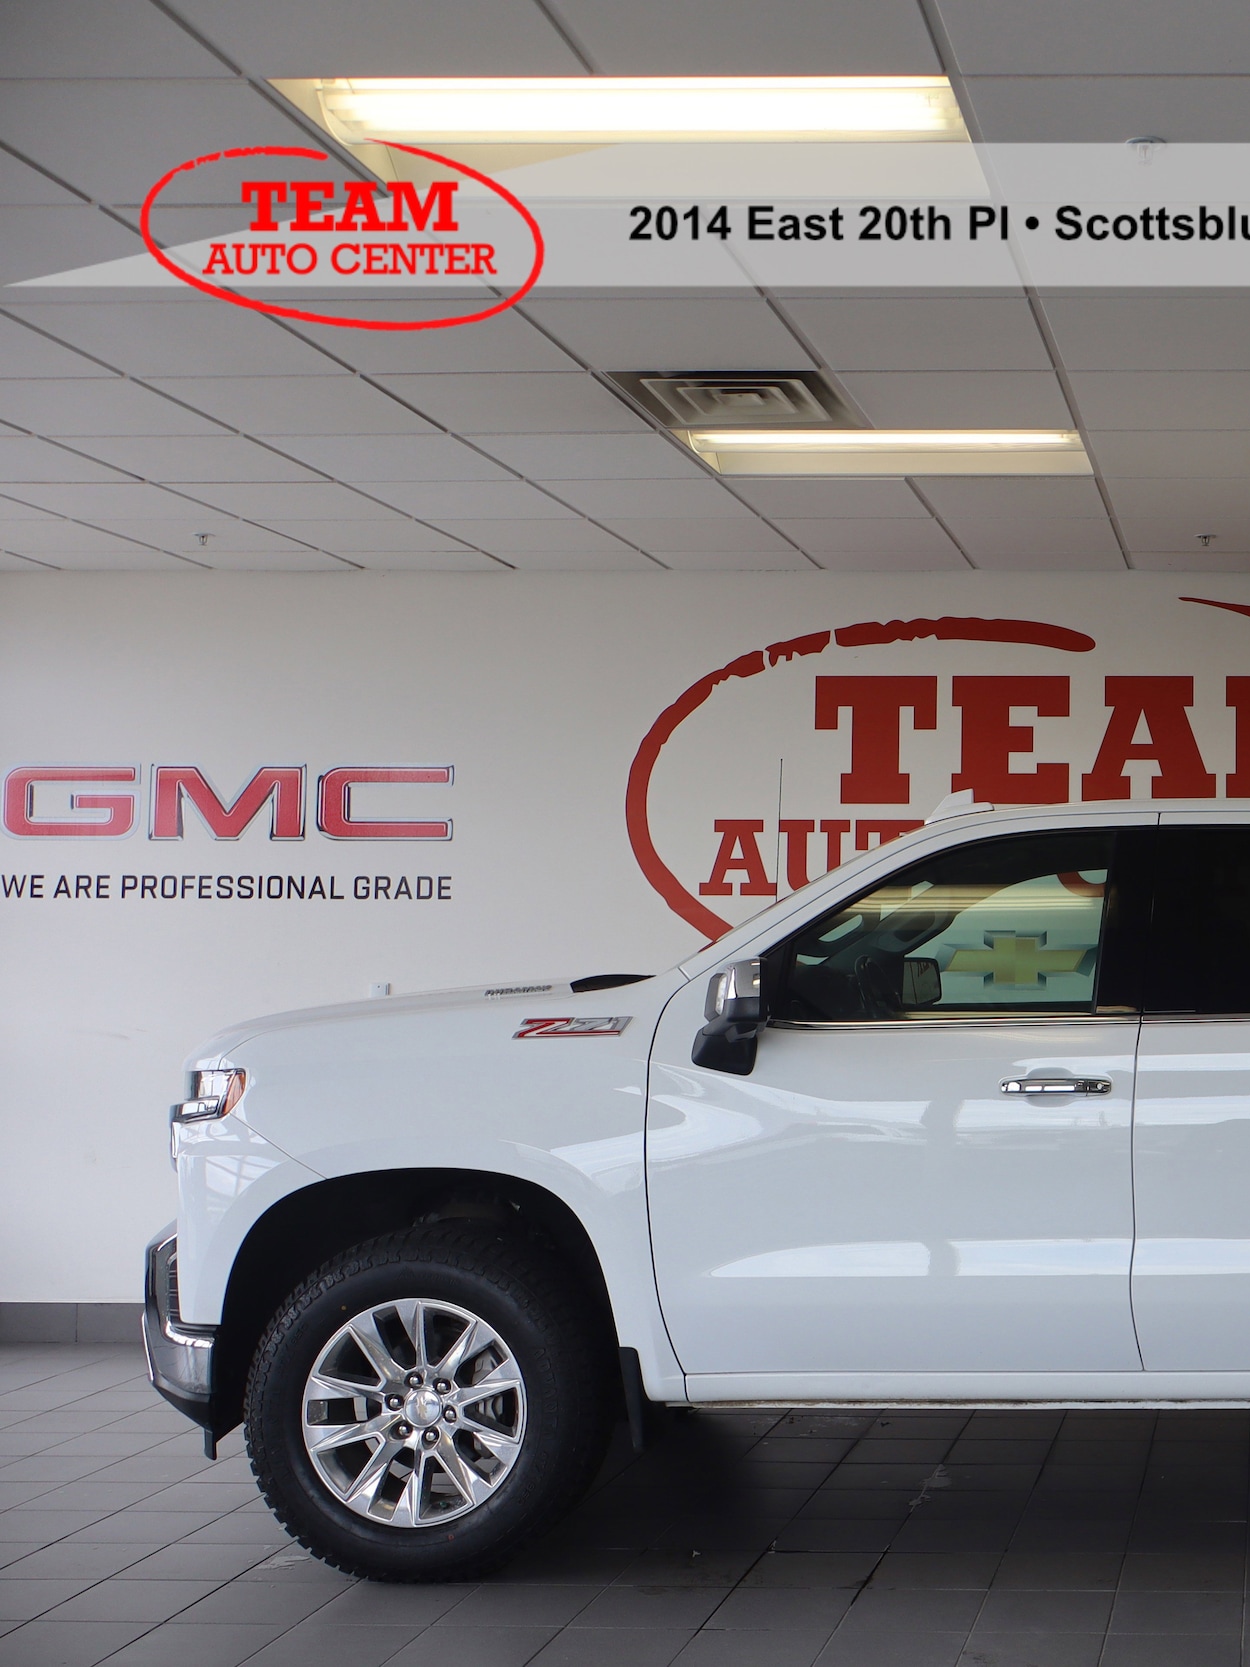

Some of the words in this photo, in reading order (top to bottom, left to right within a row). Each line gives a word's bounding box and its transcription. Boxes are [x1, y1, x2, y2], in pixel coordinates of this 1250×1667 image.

[1, 762, 455, 842] GMC
[1, 874, 45, 899] WE
[53, 874, 111, 899] ARE
[121, 875, 345, 900] PROFESSIONAL
[353, 875, 453, 900] GRADE
[512, 1016, 633, 1040] Z71
